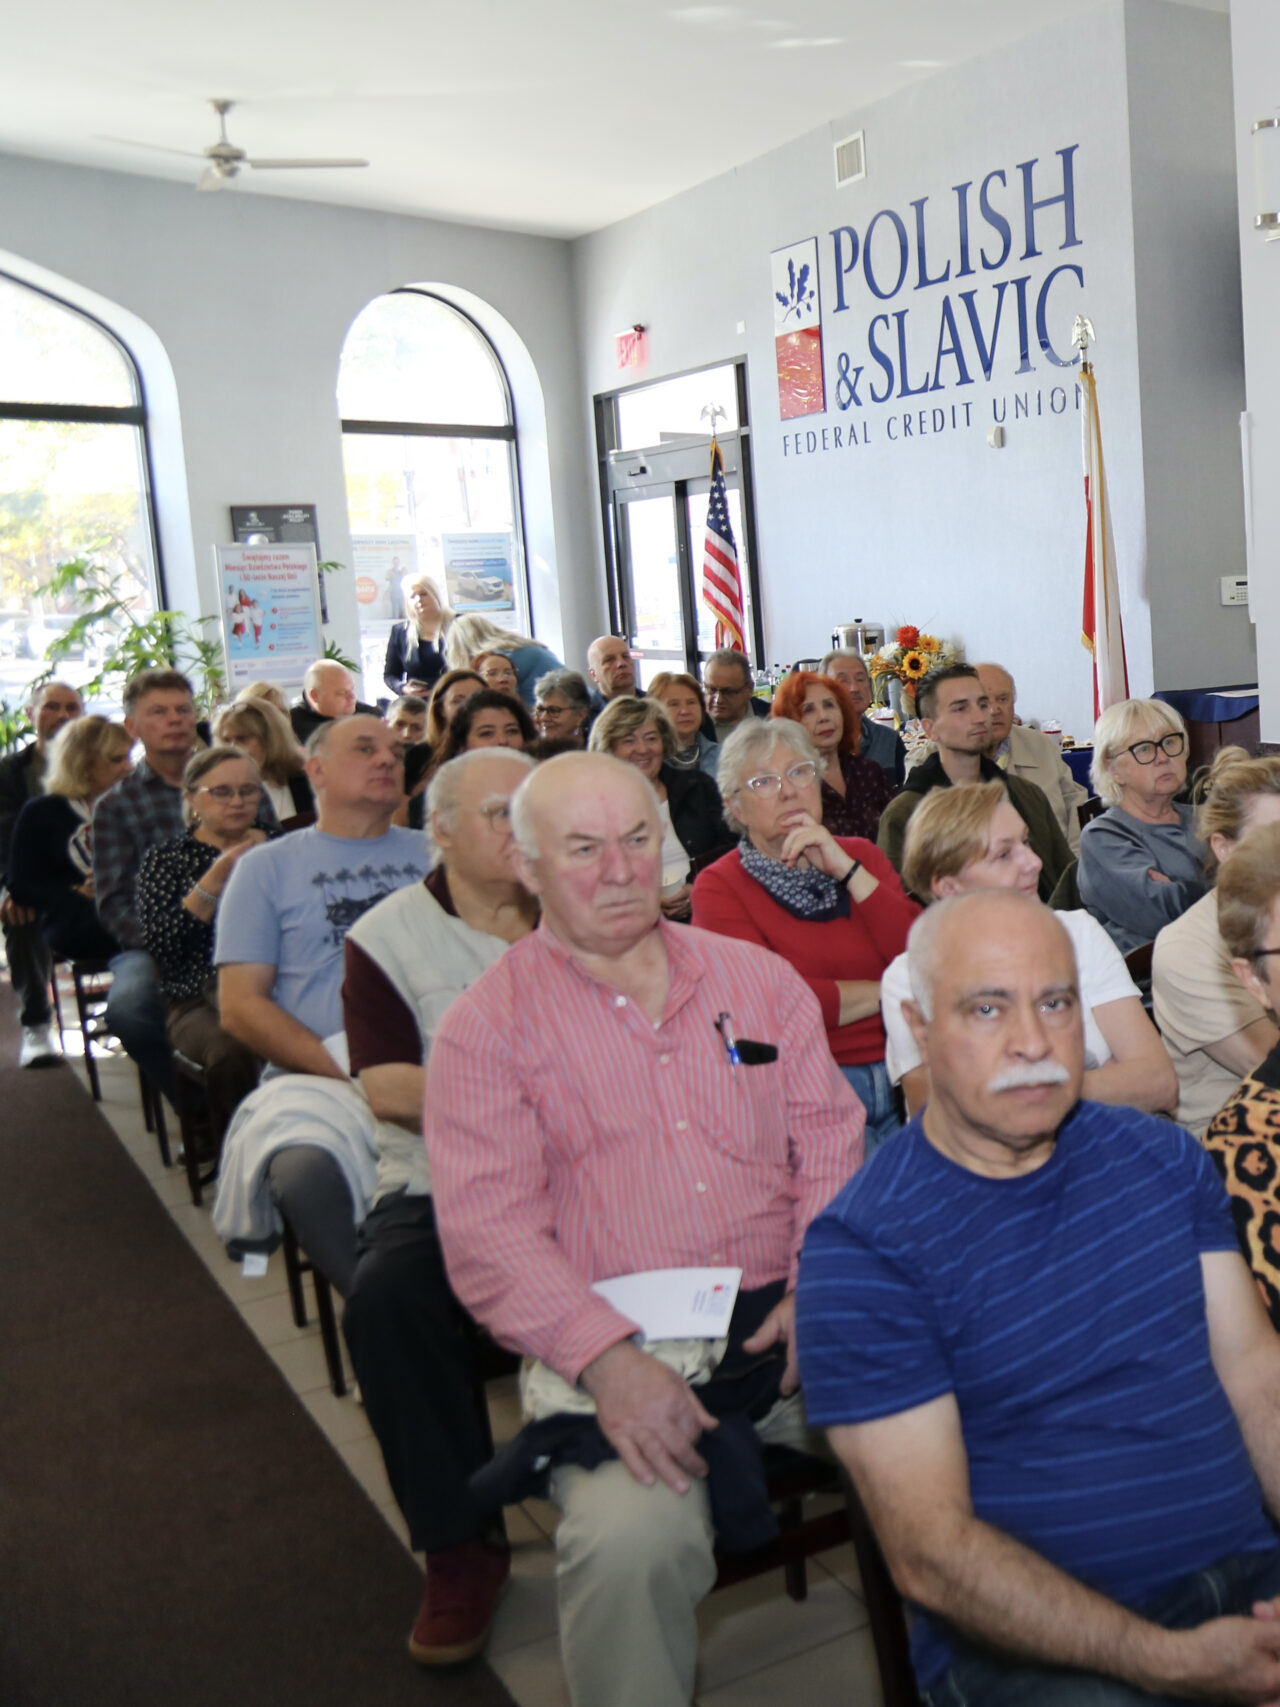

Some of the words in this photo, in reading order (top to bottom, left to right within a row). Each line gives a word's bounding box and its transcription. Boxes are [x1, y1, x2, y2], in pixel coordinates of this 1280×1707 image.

[829, 143, 1083, 314] POLISH
[834, 352, 865, 411] &
[868, 264, 1085, 404] SLAVIC
[783, 421, 872, 457] FEDERAL
[887, 401, 974, 441] CREDIT
